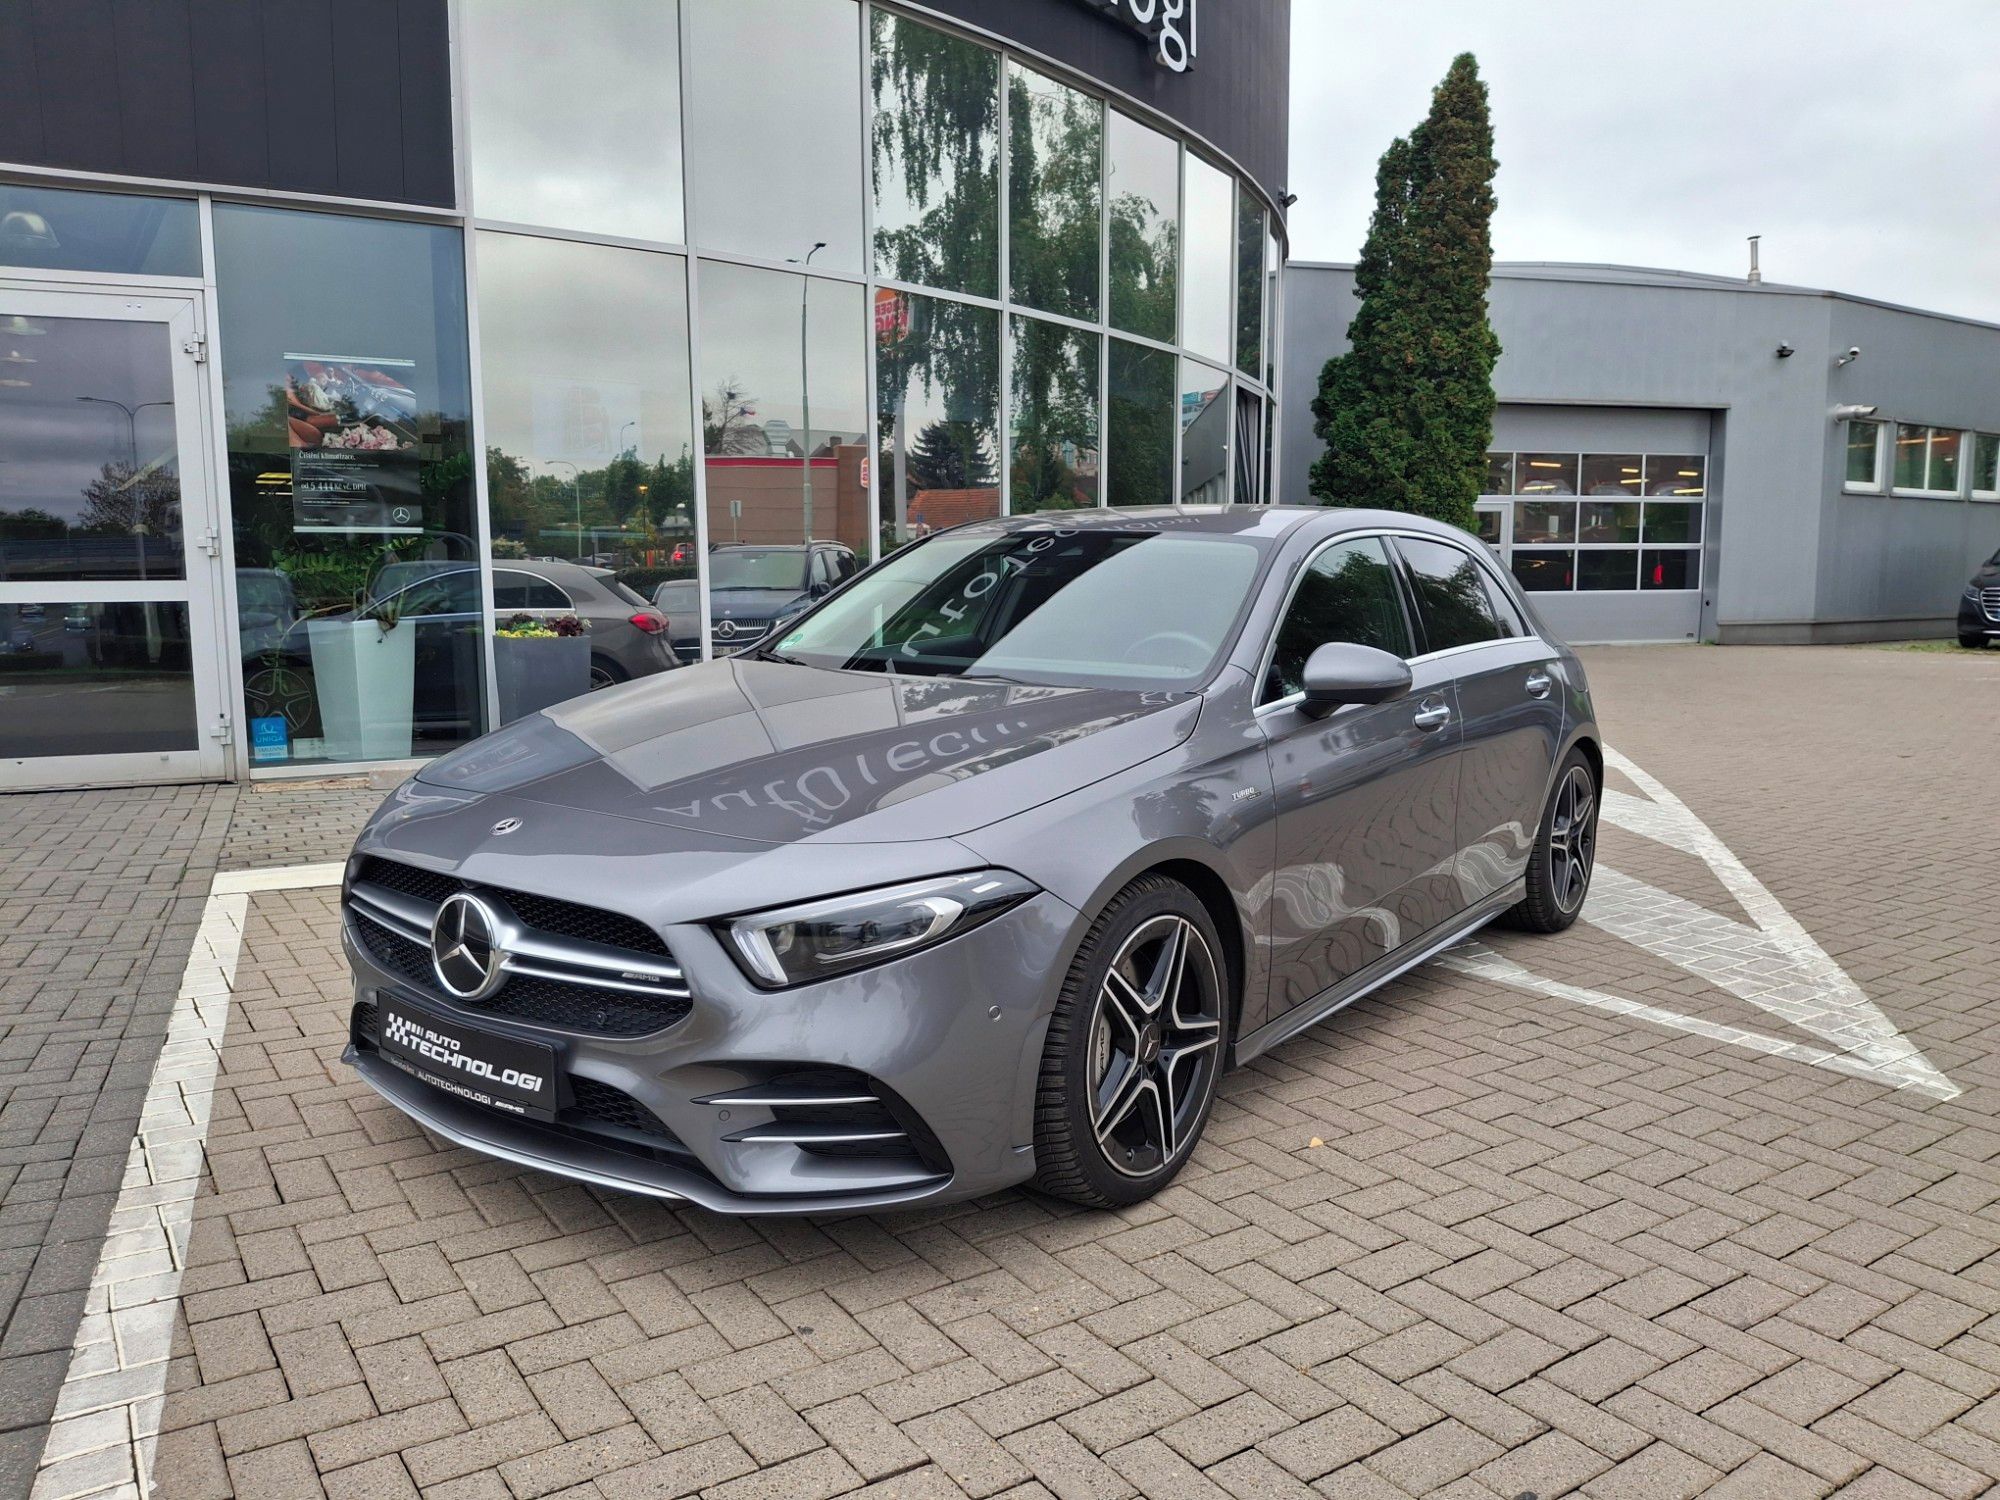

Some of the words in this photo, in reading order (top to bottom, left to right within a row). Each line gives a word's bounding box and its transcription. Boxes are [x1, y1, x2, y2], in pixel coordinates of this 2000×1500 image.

[310, 482, 316, 491] 5
[1231, 786, 1254, 801] TURBO
[425, 1030, 460, 1050] AUTO
[409, 1035, 543, 1092] TECHNOLOGI
[417, 1071, 491, 1105] AUTOTECHNOLOGI
